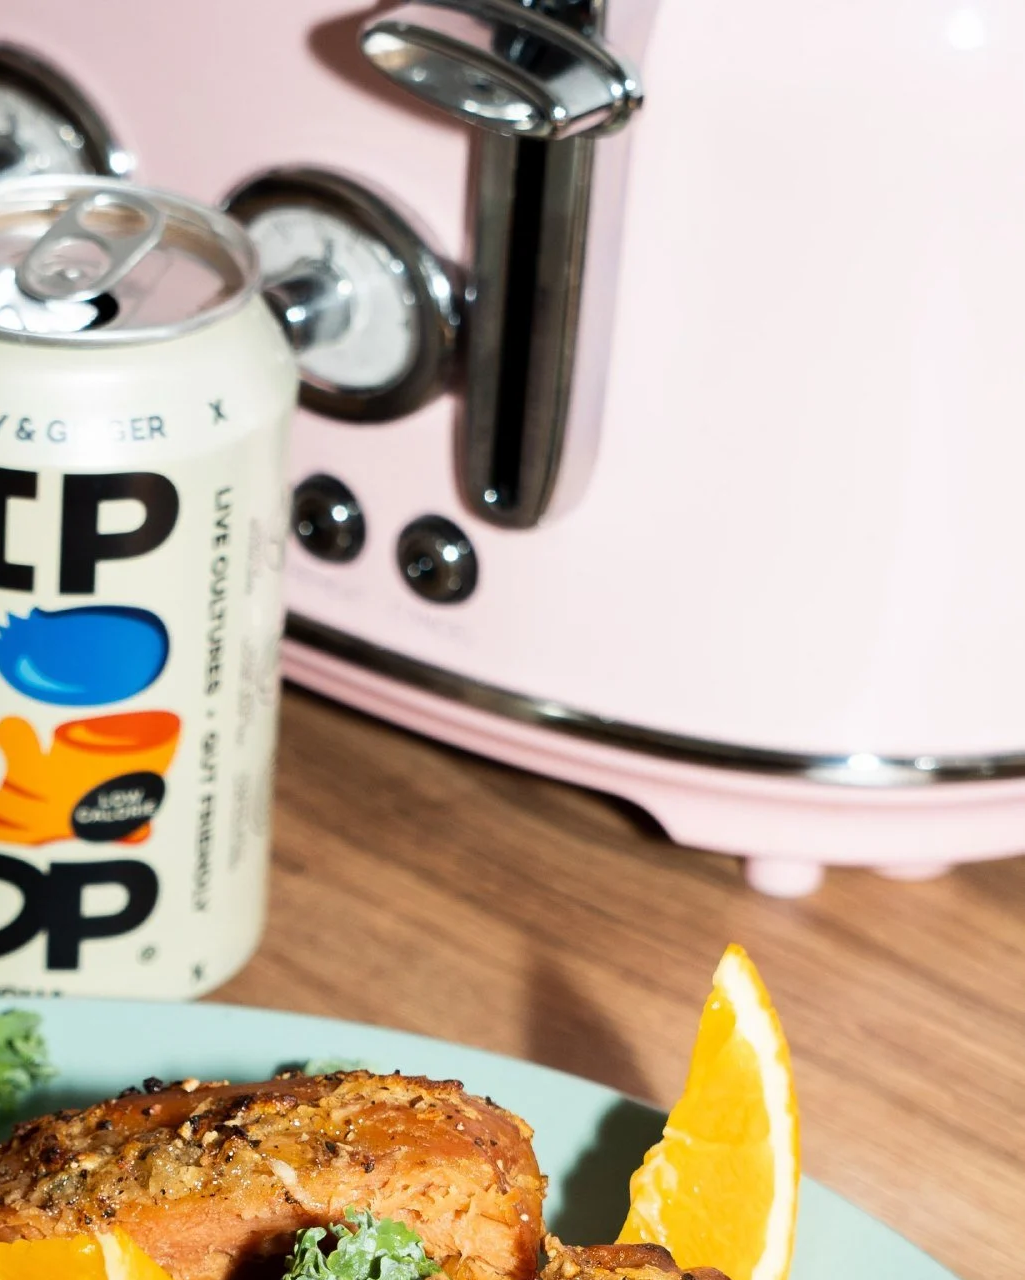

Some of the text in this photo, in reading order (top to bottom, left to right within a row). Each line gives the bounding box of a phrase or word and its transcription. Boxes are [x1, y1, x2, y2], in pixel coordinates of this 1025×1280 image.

[14, 416, 36, 442] &
[46, 414, 167, 443] GGER
[212, 486, 234, 549] LIVE
[204, 555, 231, 697] CULTURES
[97, 787, 144, 809] LOW
